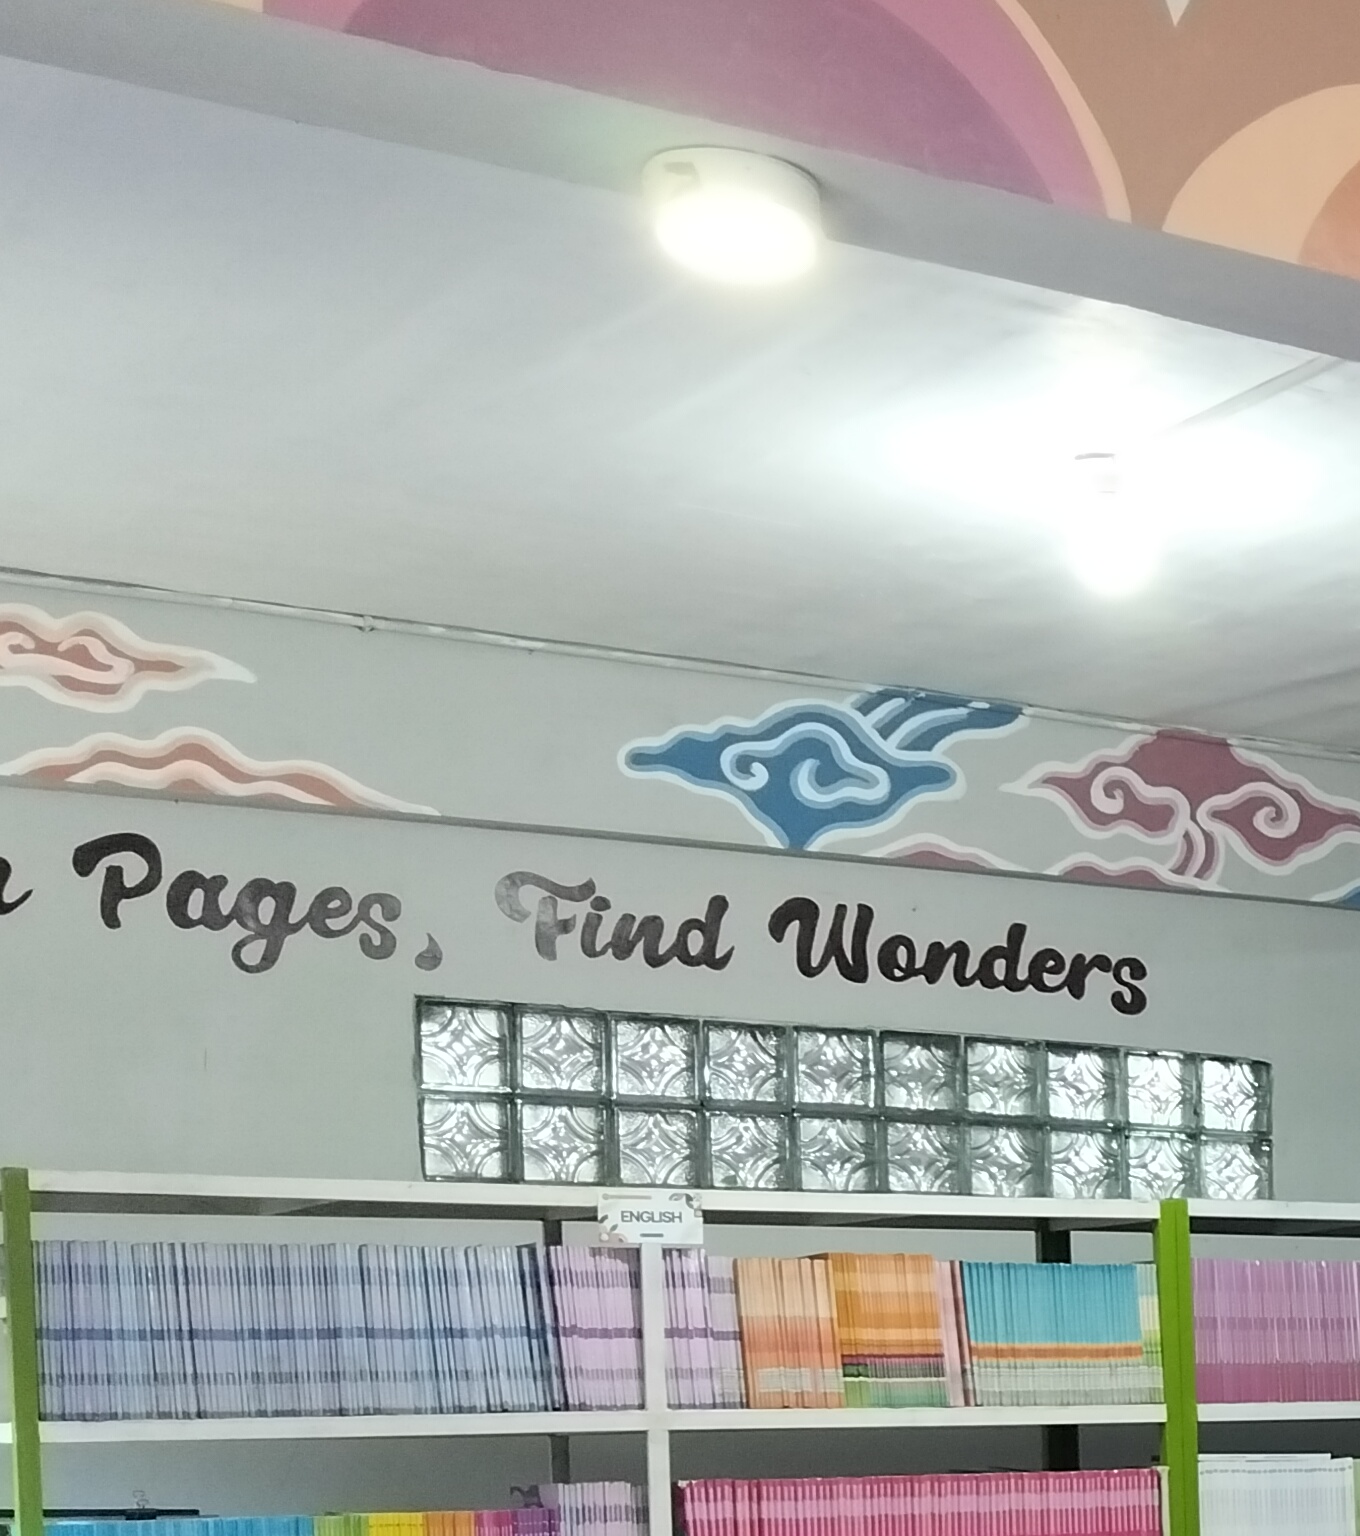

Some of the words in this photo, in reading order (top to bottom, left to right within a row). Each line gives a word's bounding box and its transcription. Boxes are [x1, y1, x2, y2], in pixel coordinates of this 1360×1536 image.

[494, 870, 735, 971] Find
[768, 896, 1149, 1016] Wonders
[620, 1210, 683, 1223] ENGLISH
